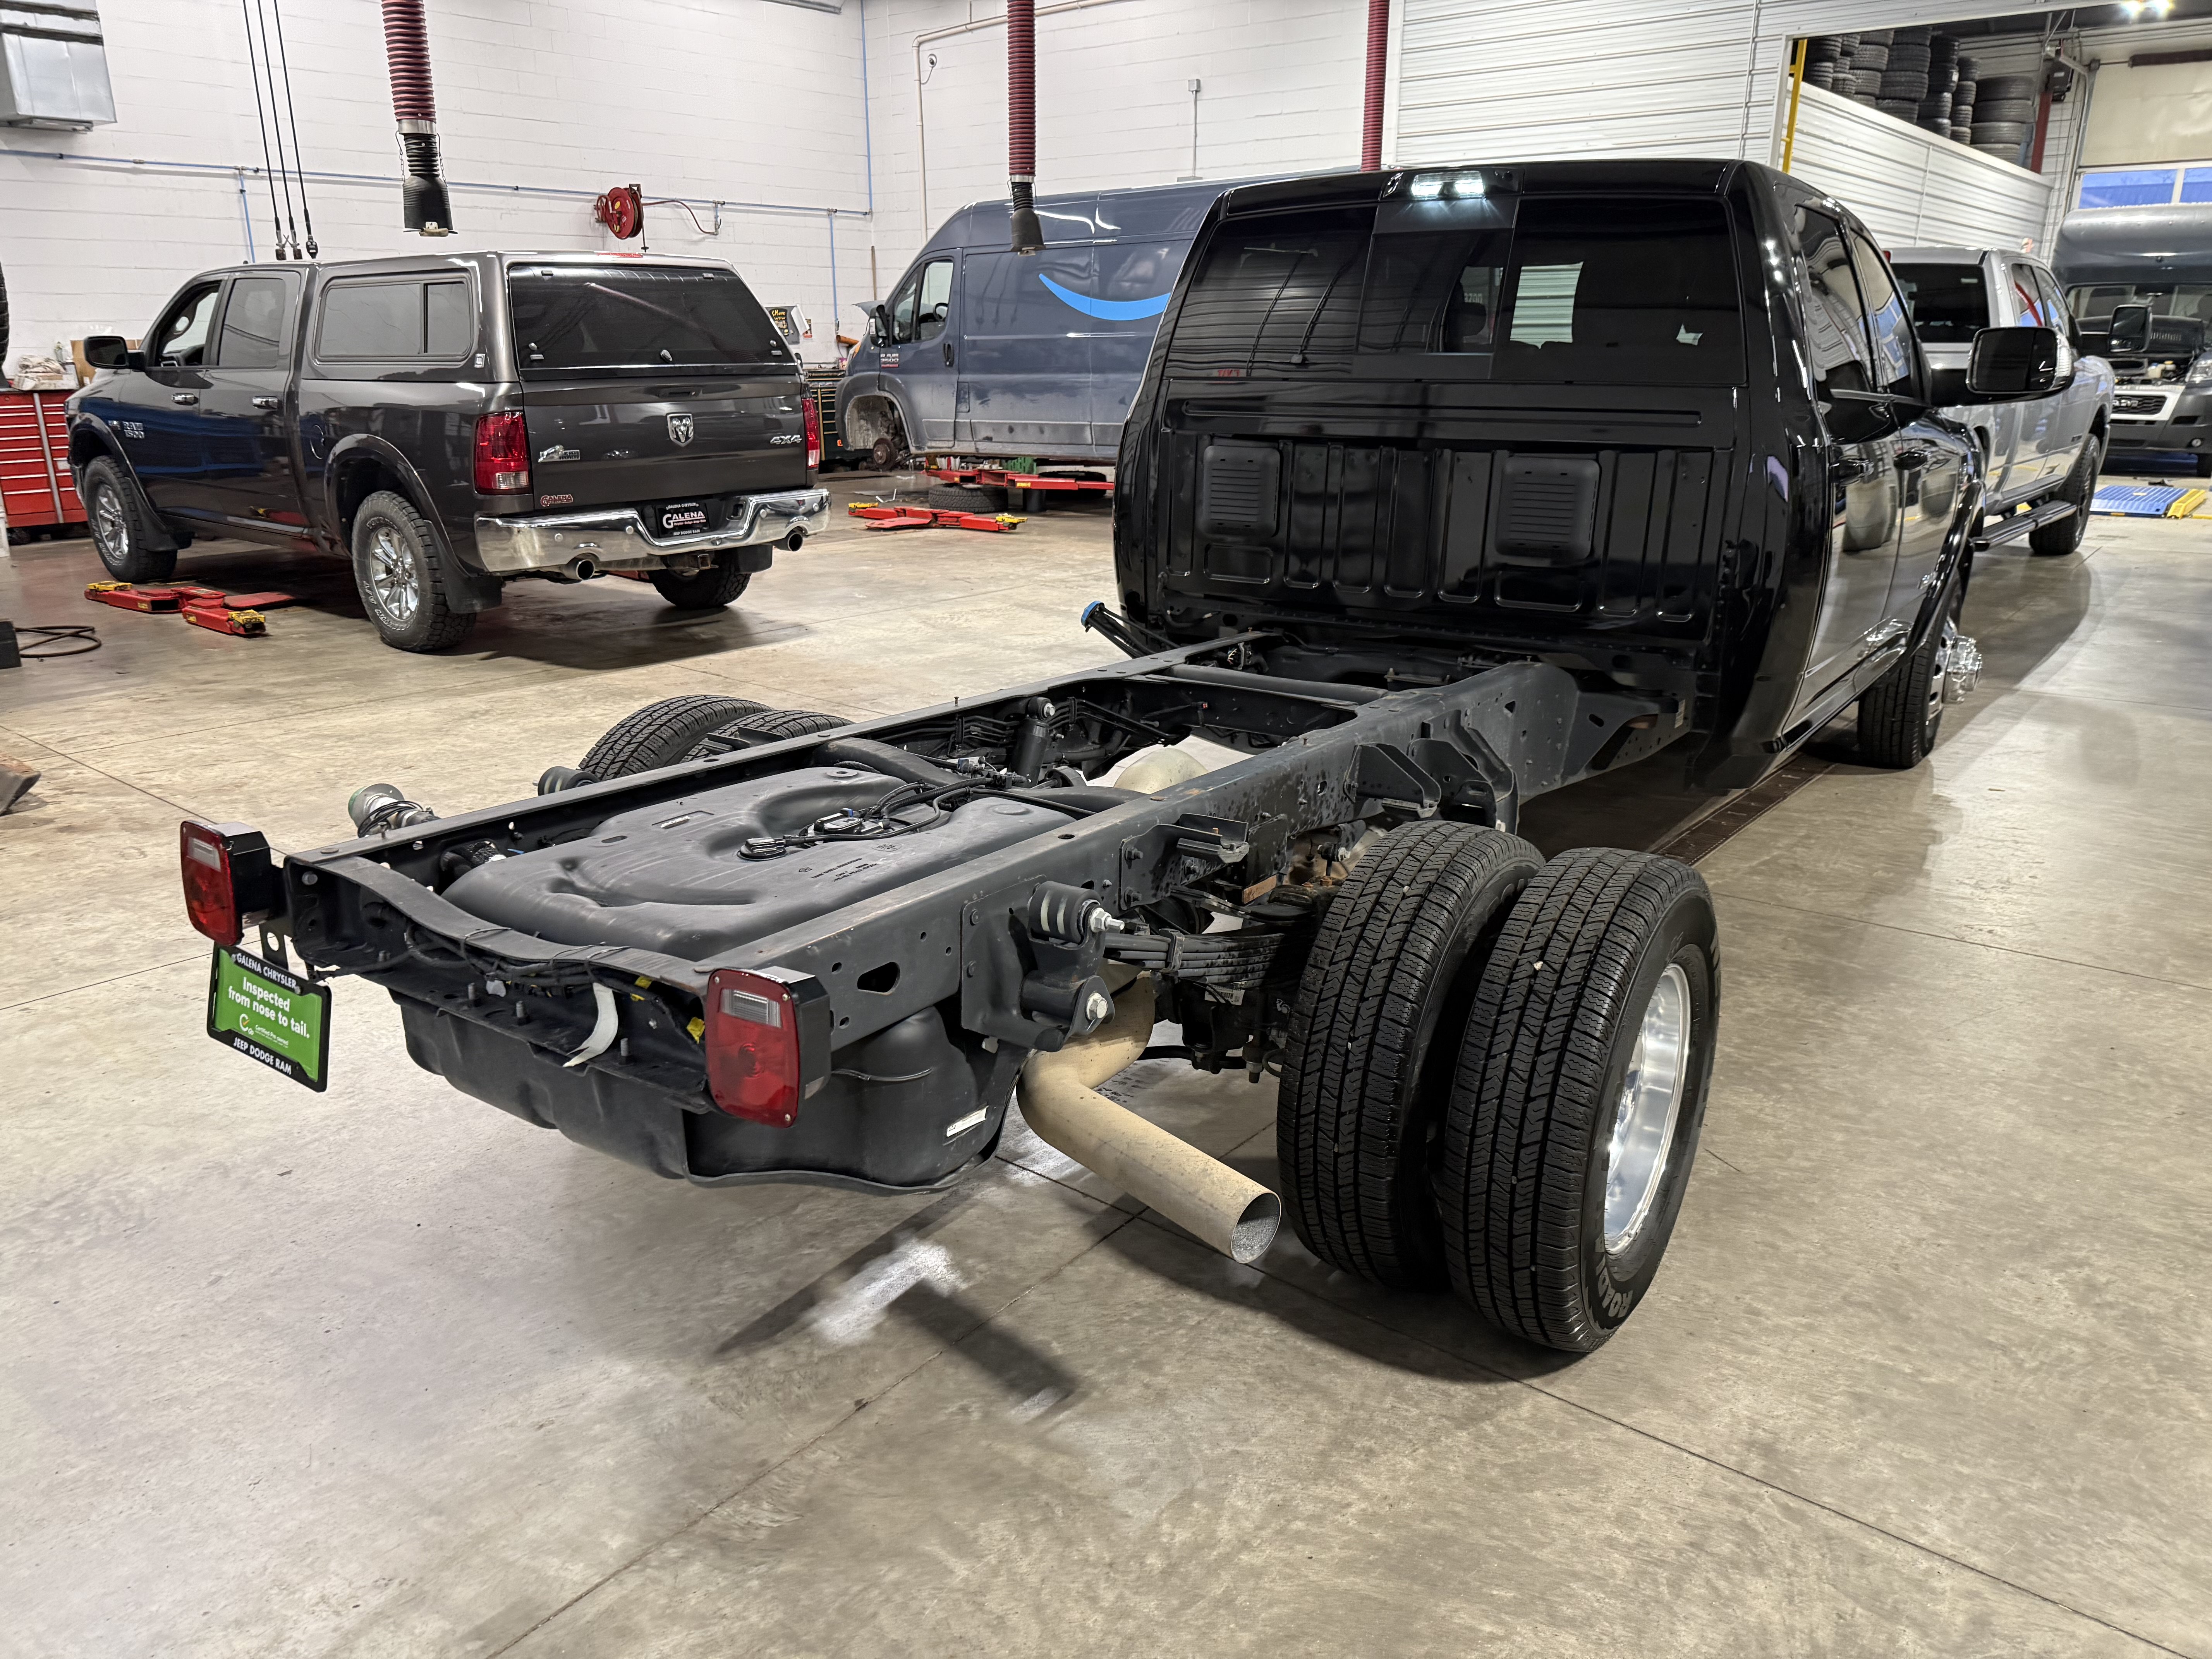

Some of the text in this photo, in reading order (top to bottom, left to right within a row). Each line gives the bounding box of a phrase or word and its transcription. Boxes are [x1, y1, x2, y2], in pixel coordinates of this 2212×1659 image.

[663, 511, 704, 529] GALENA
[237, 953, 297, 989] GALENA CHRYSLER
[228, 986, 310, 1039] from nose to tail.
[243, 977, 290, 1012] Inspected
[233, 1037, 248, 1051] JEEP
[250, 1045, 274, 1065] DODGE
[275, 1058, 291, 1075] RAM
